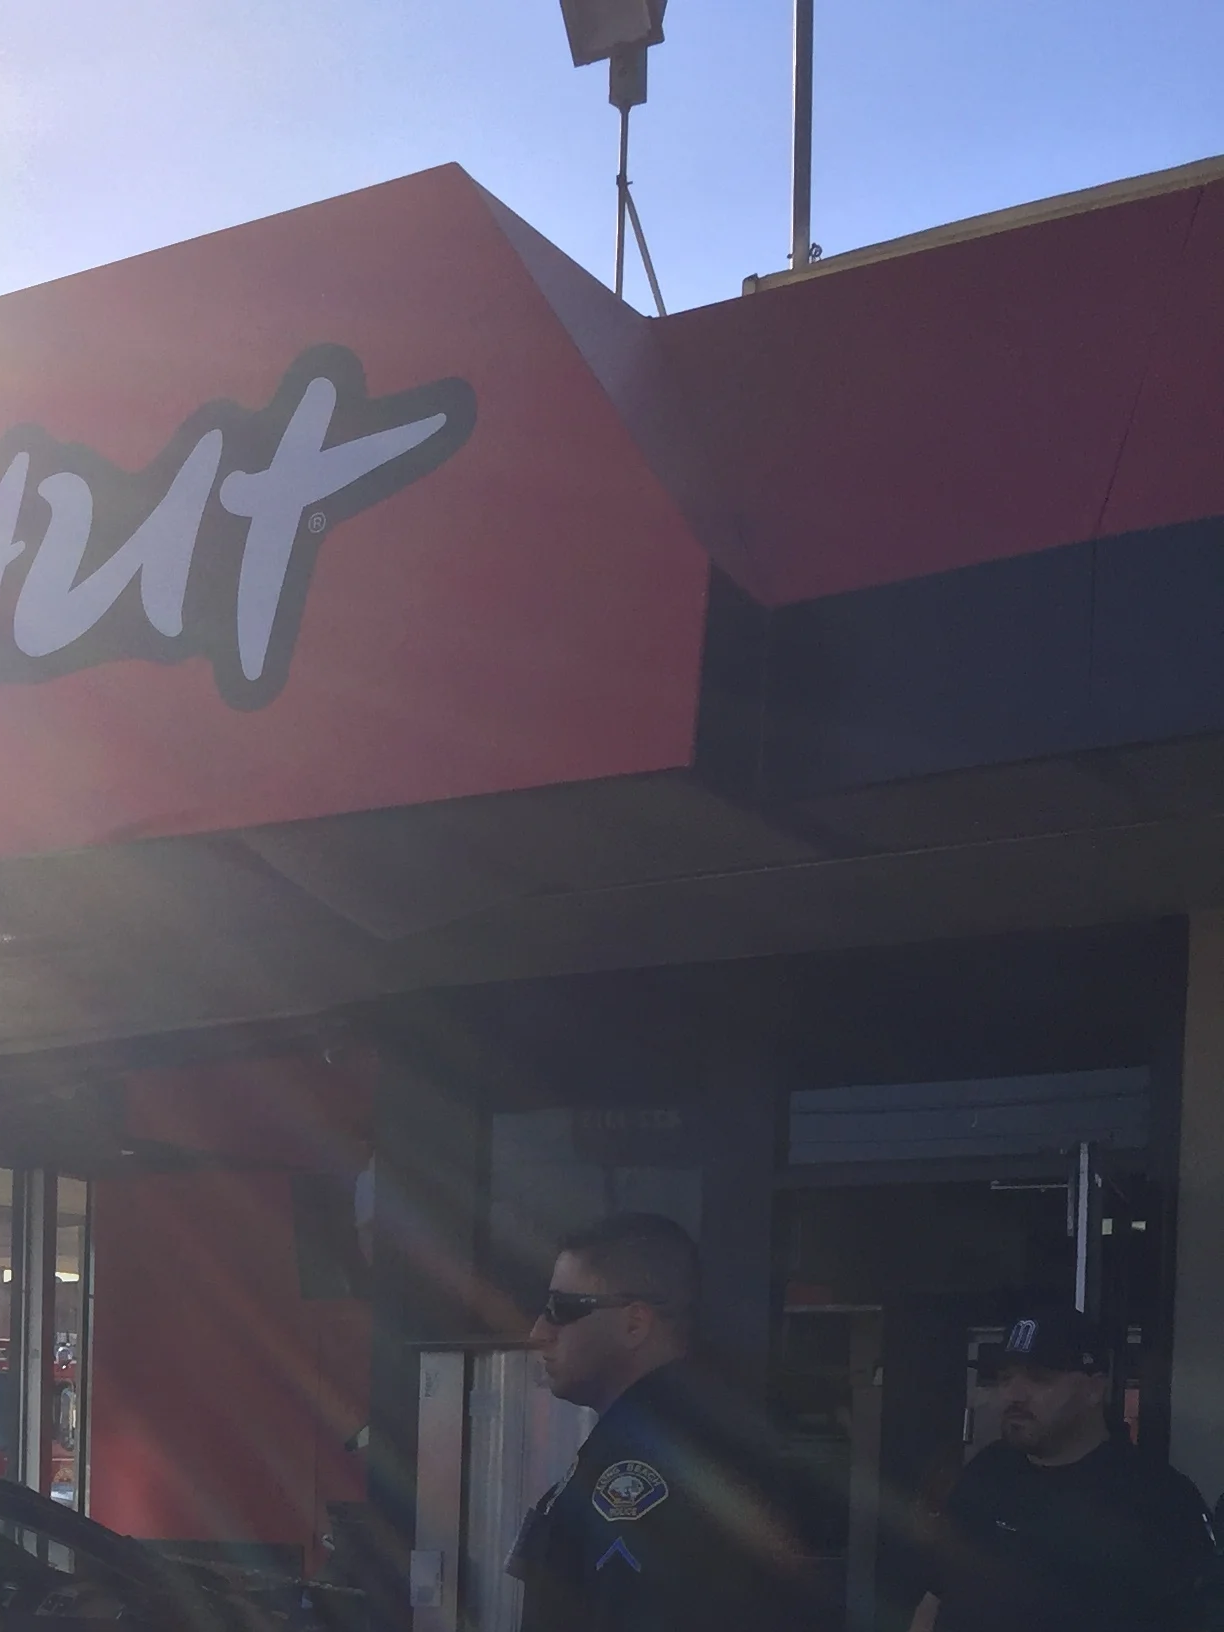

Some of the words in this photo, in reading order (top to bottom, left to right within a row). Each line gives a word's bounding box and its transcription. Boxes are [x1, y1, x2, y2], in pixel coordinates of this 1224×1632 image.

[596, 1465, 621, 1492] LONG
[626, 1462, 663, 1487] BEACH
[608, 1506, 638, 1518] POLICE
